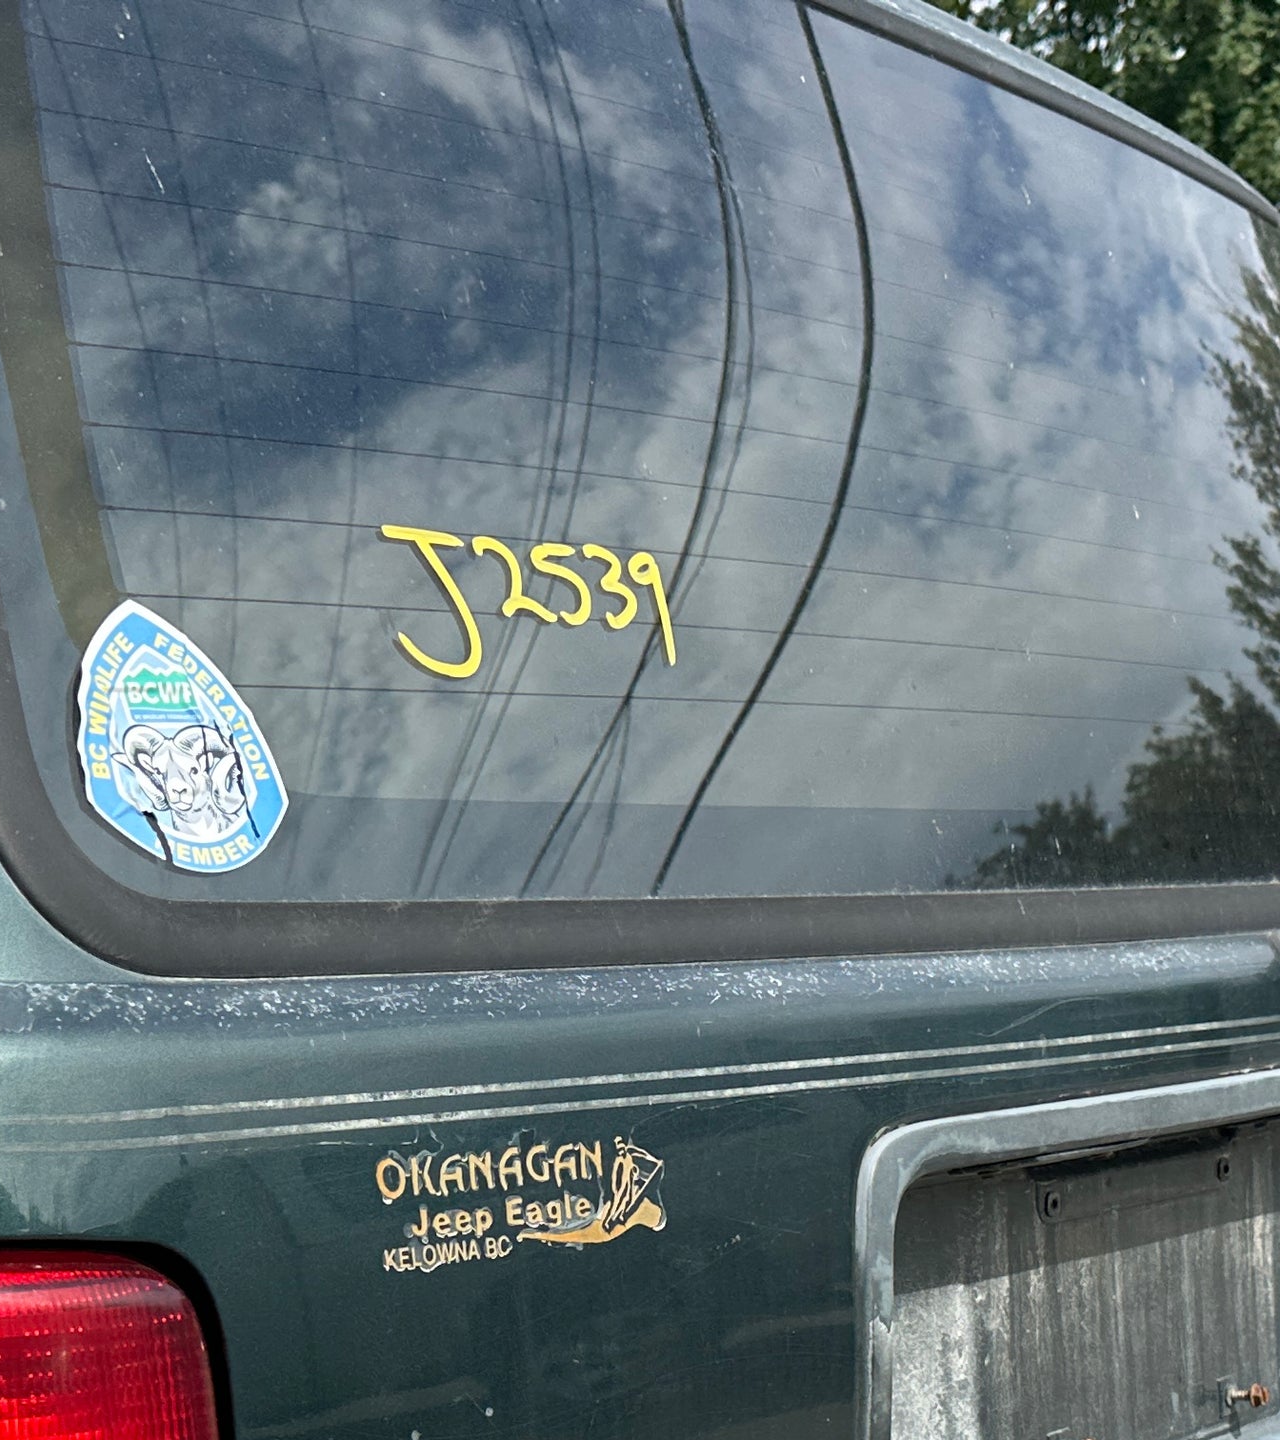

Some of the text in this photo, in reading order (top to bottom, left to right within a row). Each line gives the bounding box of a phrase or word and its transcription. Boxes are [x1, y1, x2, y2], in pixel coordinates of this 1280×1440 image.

[381, 525, 676, 678] J2539
[154, 632, 270, 780] FEDERATION
[89, 743, 111, 780] BC
[376, 1141, 603, 1199] OKANAGAN
[412, 1192, 592, 1237] Jeep Eagle
[384, 1236, 512, 1270] KELOWNA BC
